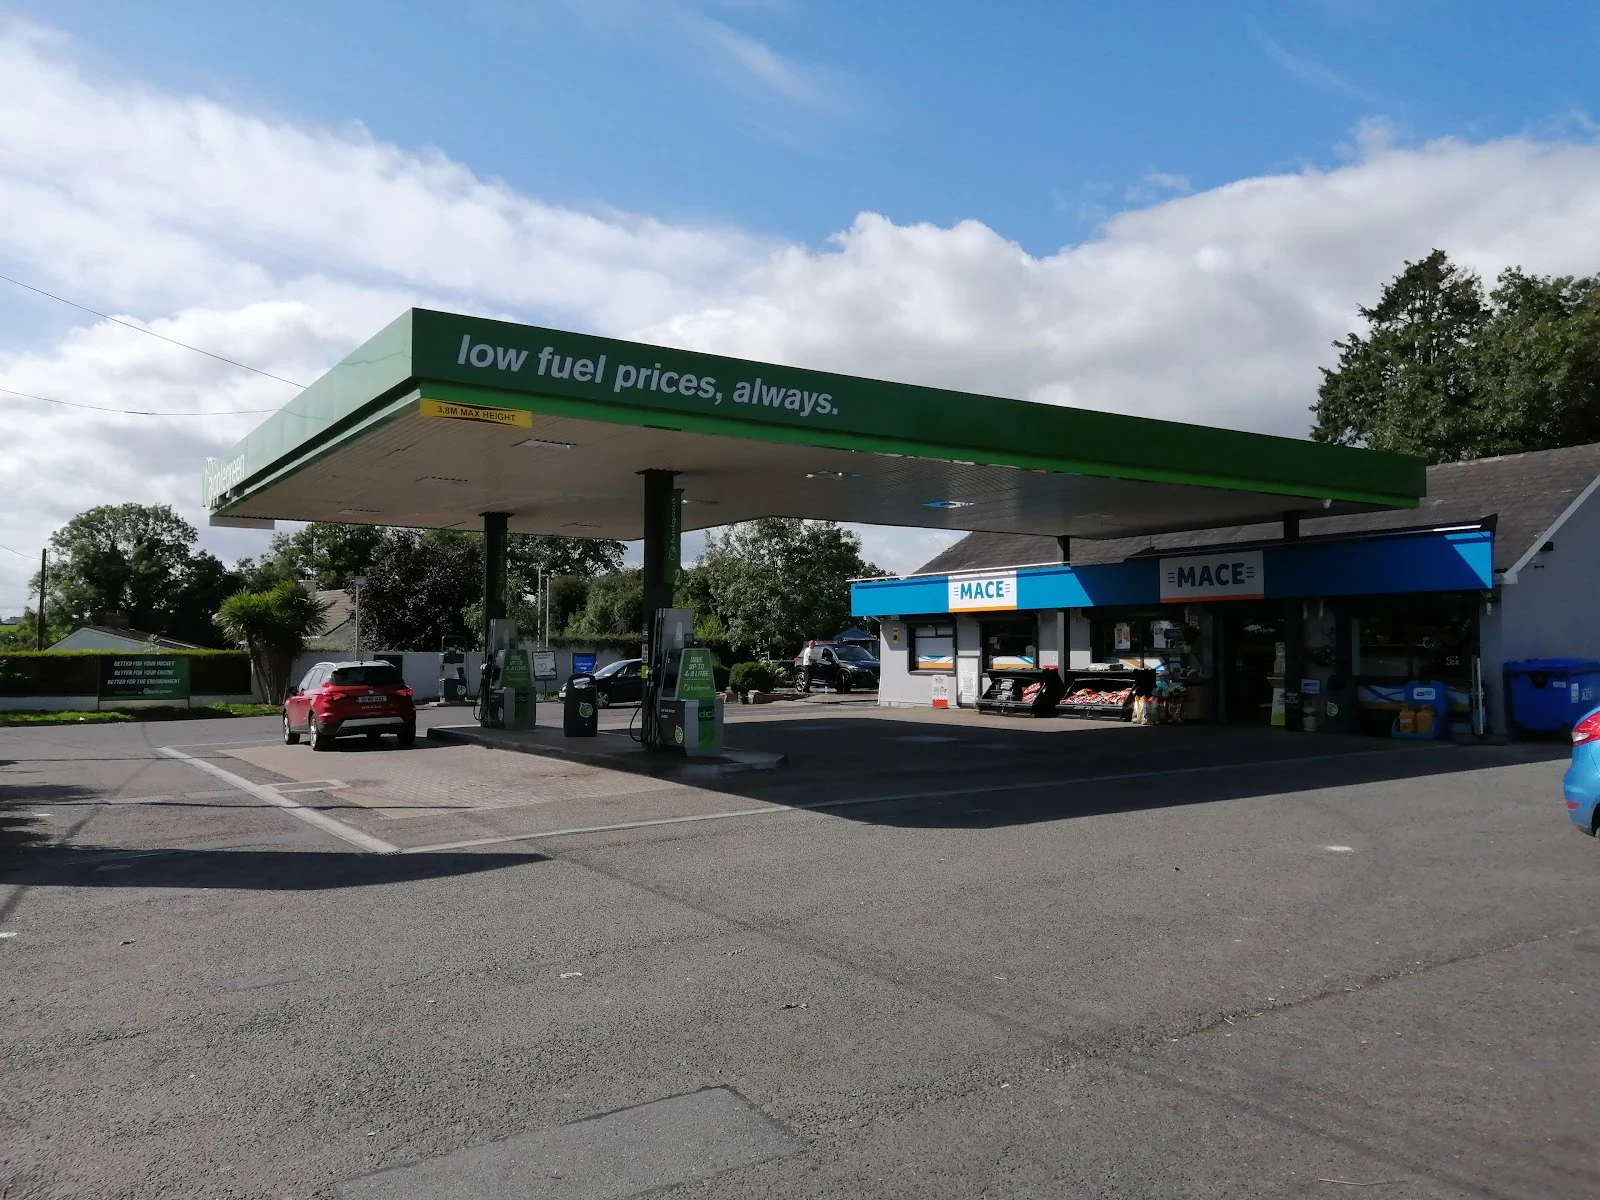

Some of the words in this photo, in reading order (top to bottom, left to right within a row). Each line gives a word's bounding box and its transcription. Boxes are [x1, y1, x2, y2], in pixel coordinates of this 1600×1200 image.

[457, 334, 529, 372] low
[537, 346, 606, 383] fuel
[614, 363, 723, 405] prices,
[732, 377, 839, 417] always.
[437, 405, 458, 415] 3.8M
[460, 408, 480, 418] MAX
[482, 411, 516, 422] HEIGHT
[674, 568, 681, 586] 2
[1176, 562, 1245, 588] MACE
[960, 580, 1005, 600] MACE
